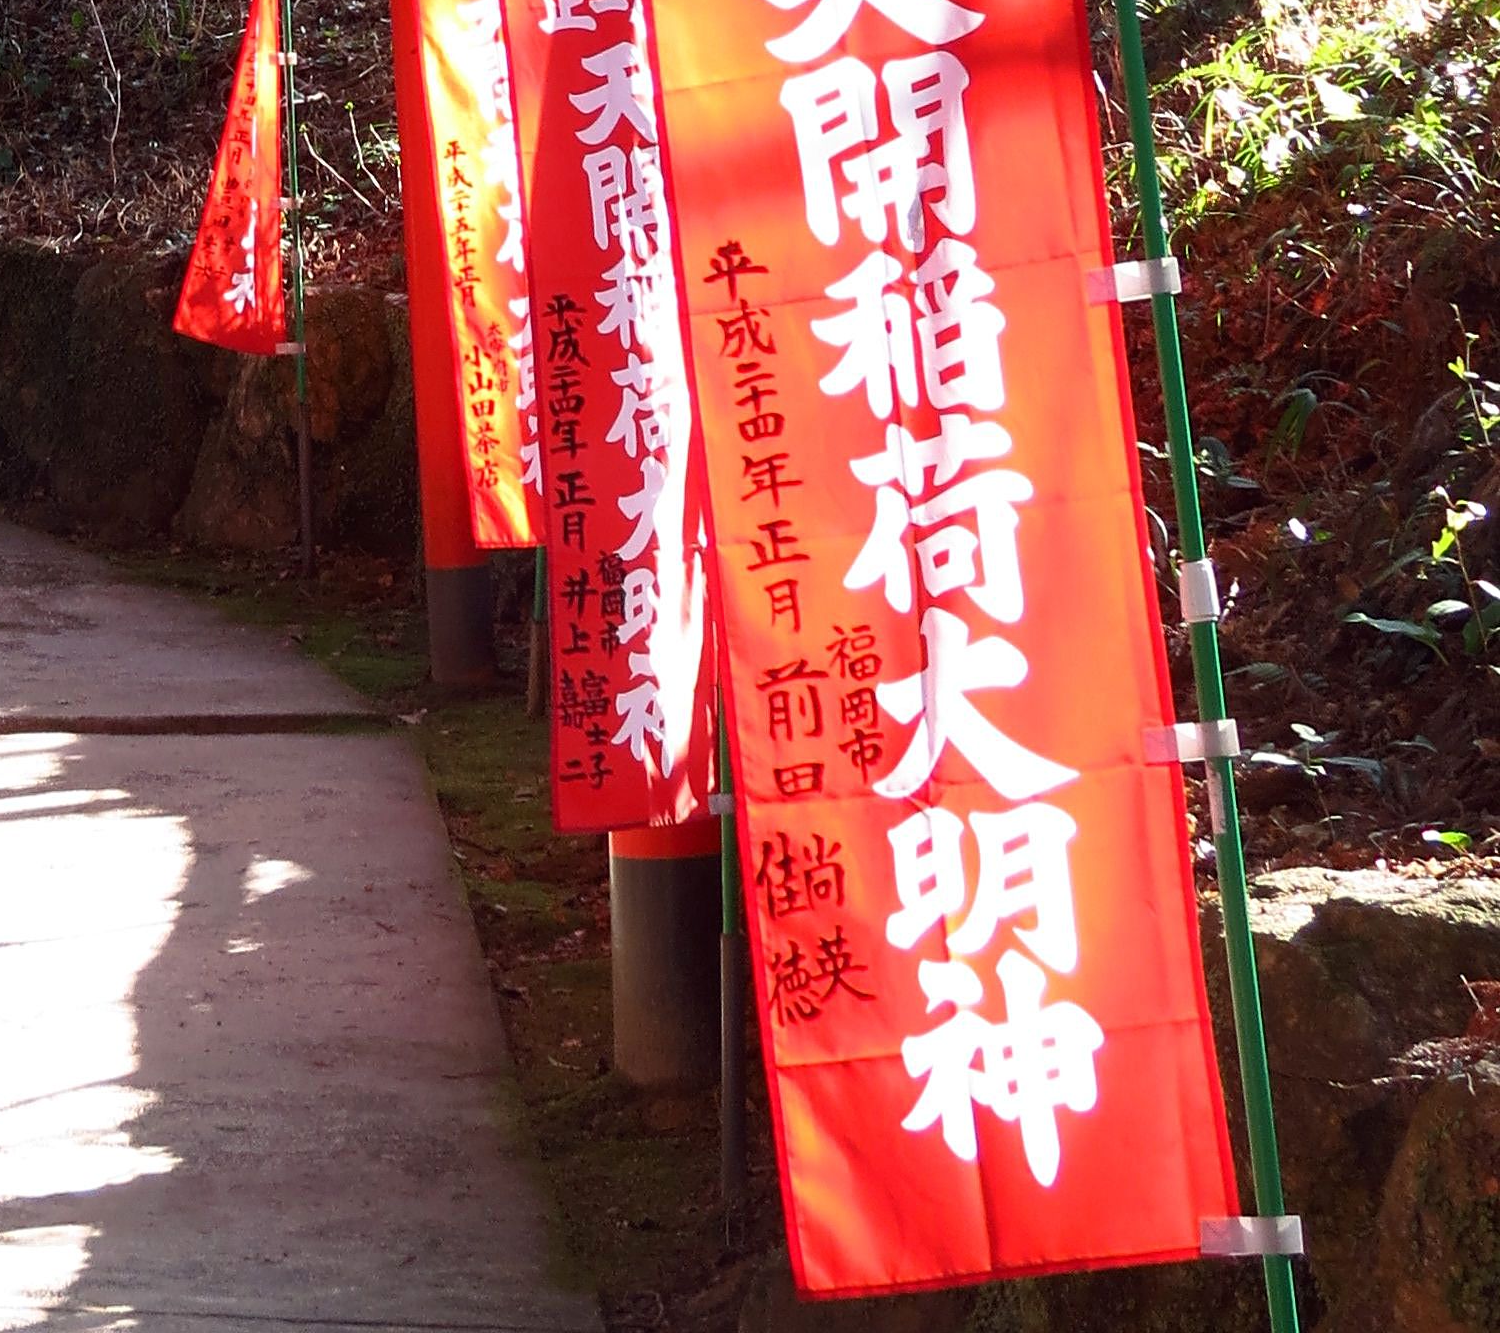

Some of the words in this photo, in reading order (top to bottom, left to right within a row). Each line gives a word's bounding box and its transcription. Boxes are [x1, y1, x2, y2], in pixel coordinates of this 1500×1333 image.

[443, 139, 482, 309] 平成二十五年正月
[464, 345, 501, 489] 小山田茶店
[542, 293, 596, 553] 平成二十四年正月
[703, 239, 810, 633] 平成二十四年正月
[561, 567, 598, 656] 井上
[826, 624, 885, 784] 福岡市
[756, 658, 829, 798] 前田
